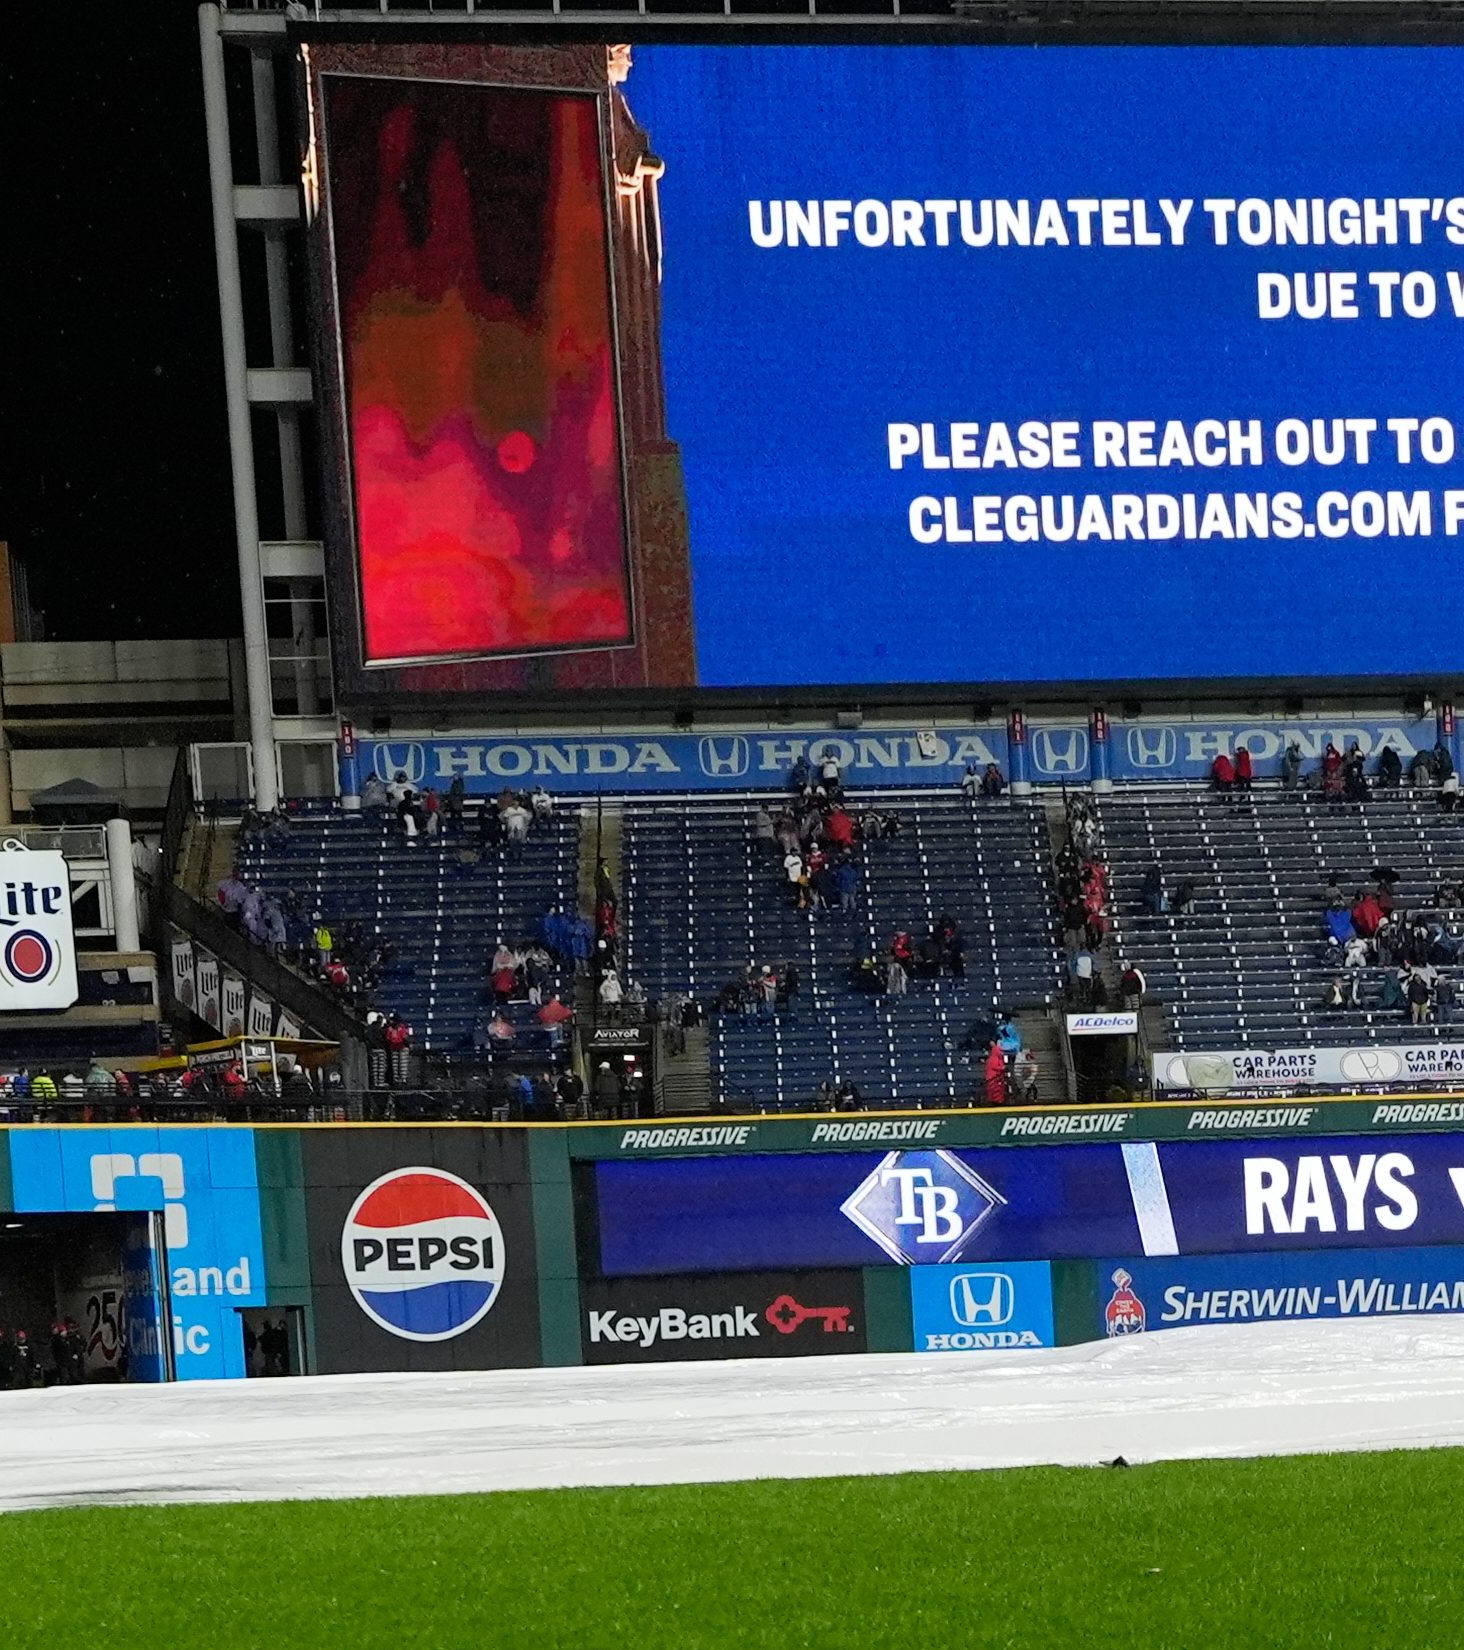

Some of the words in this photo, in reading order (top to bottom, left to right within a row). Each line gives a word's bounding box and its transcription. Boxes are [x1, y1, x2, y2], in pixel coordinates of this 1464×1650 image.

[748, 199, 1193, 247] UNFORTUNATELY
[1258, 271, 1359, 319] DUE
[1369, 271, 1438, 318] TO
[888, 421, 1081, 470] PLEASE
[1093, 419, 1263, 468] REACH
[1274, 418, 1381, 466] OUT
[1387, 417, 1457, 465] TO
[908, 491, 1432, 543] CLEGUARDIANS.COM
[435, 740, 682, 778] HONDA
[758, 734, 1000, 770] HONDA
[1184, 727, 1416, 763] HONDA
[1073, 1016, 1134, 1027] ACDelco
[1233, 1056, 1264, 1068] CAR
[1268, 1054, 1317, 1067] PARTS
[1236, 1067, 1315, 1079] WAREHOUSE
[1405, 1051, 1436, 1062] CAR
[811, 1120, 942, 1143] PROGRESSIVE
[1000, 1113, 1129, 1135] PROGRESSIVE
[1187, 1108, 1314, 1130] PROGRESSIVE
[620, 1126, 751, 1149] PROGRESSIVE
[880, 1167, 963, 1243] TB
[1243, 1151, 1419, 1235] RAYS
[353, 1235, 494, 1272] PEPSI
[589, 1305, 759, 1348] KeyBank
[926, 1330, 1044, 1352] HONDA
